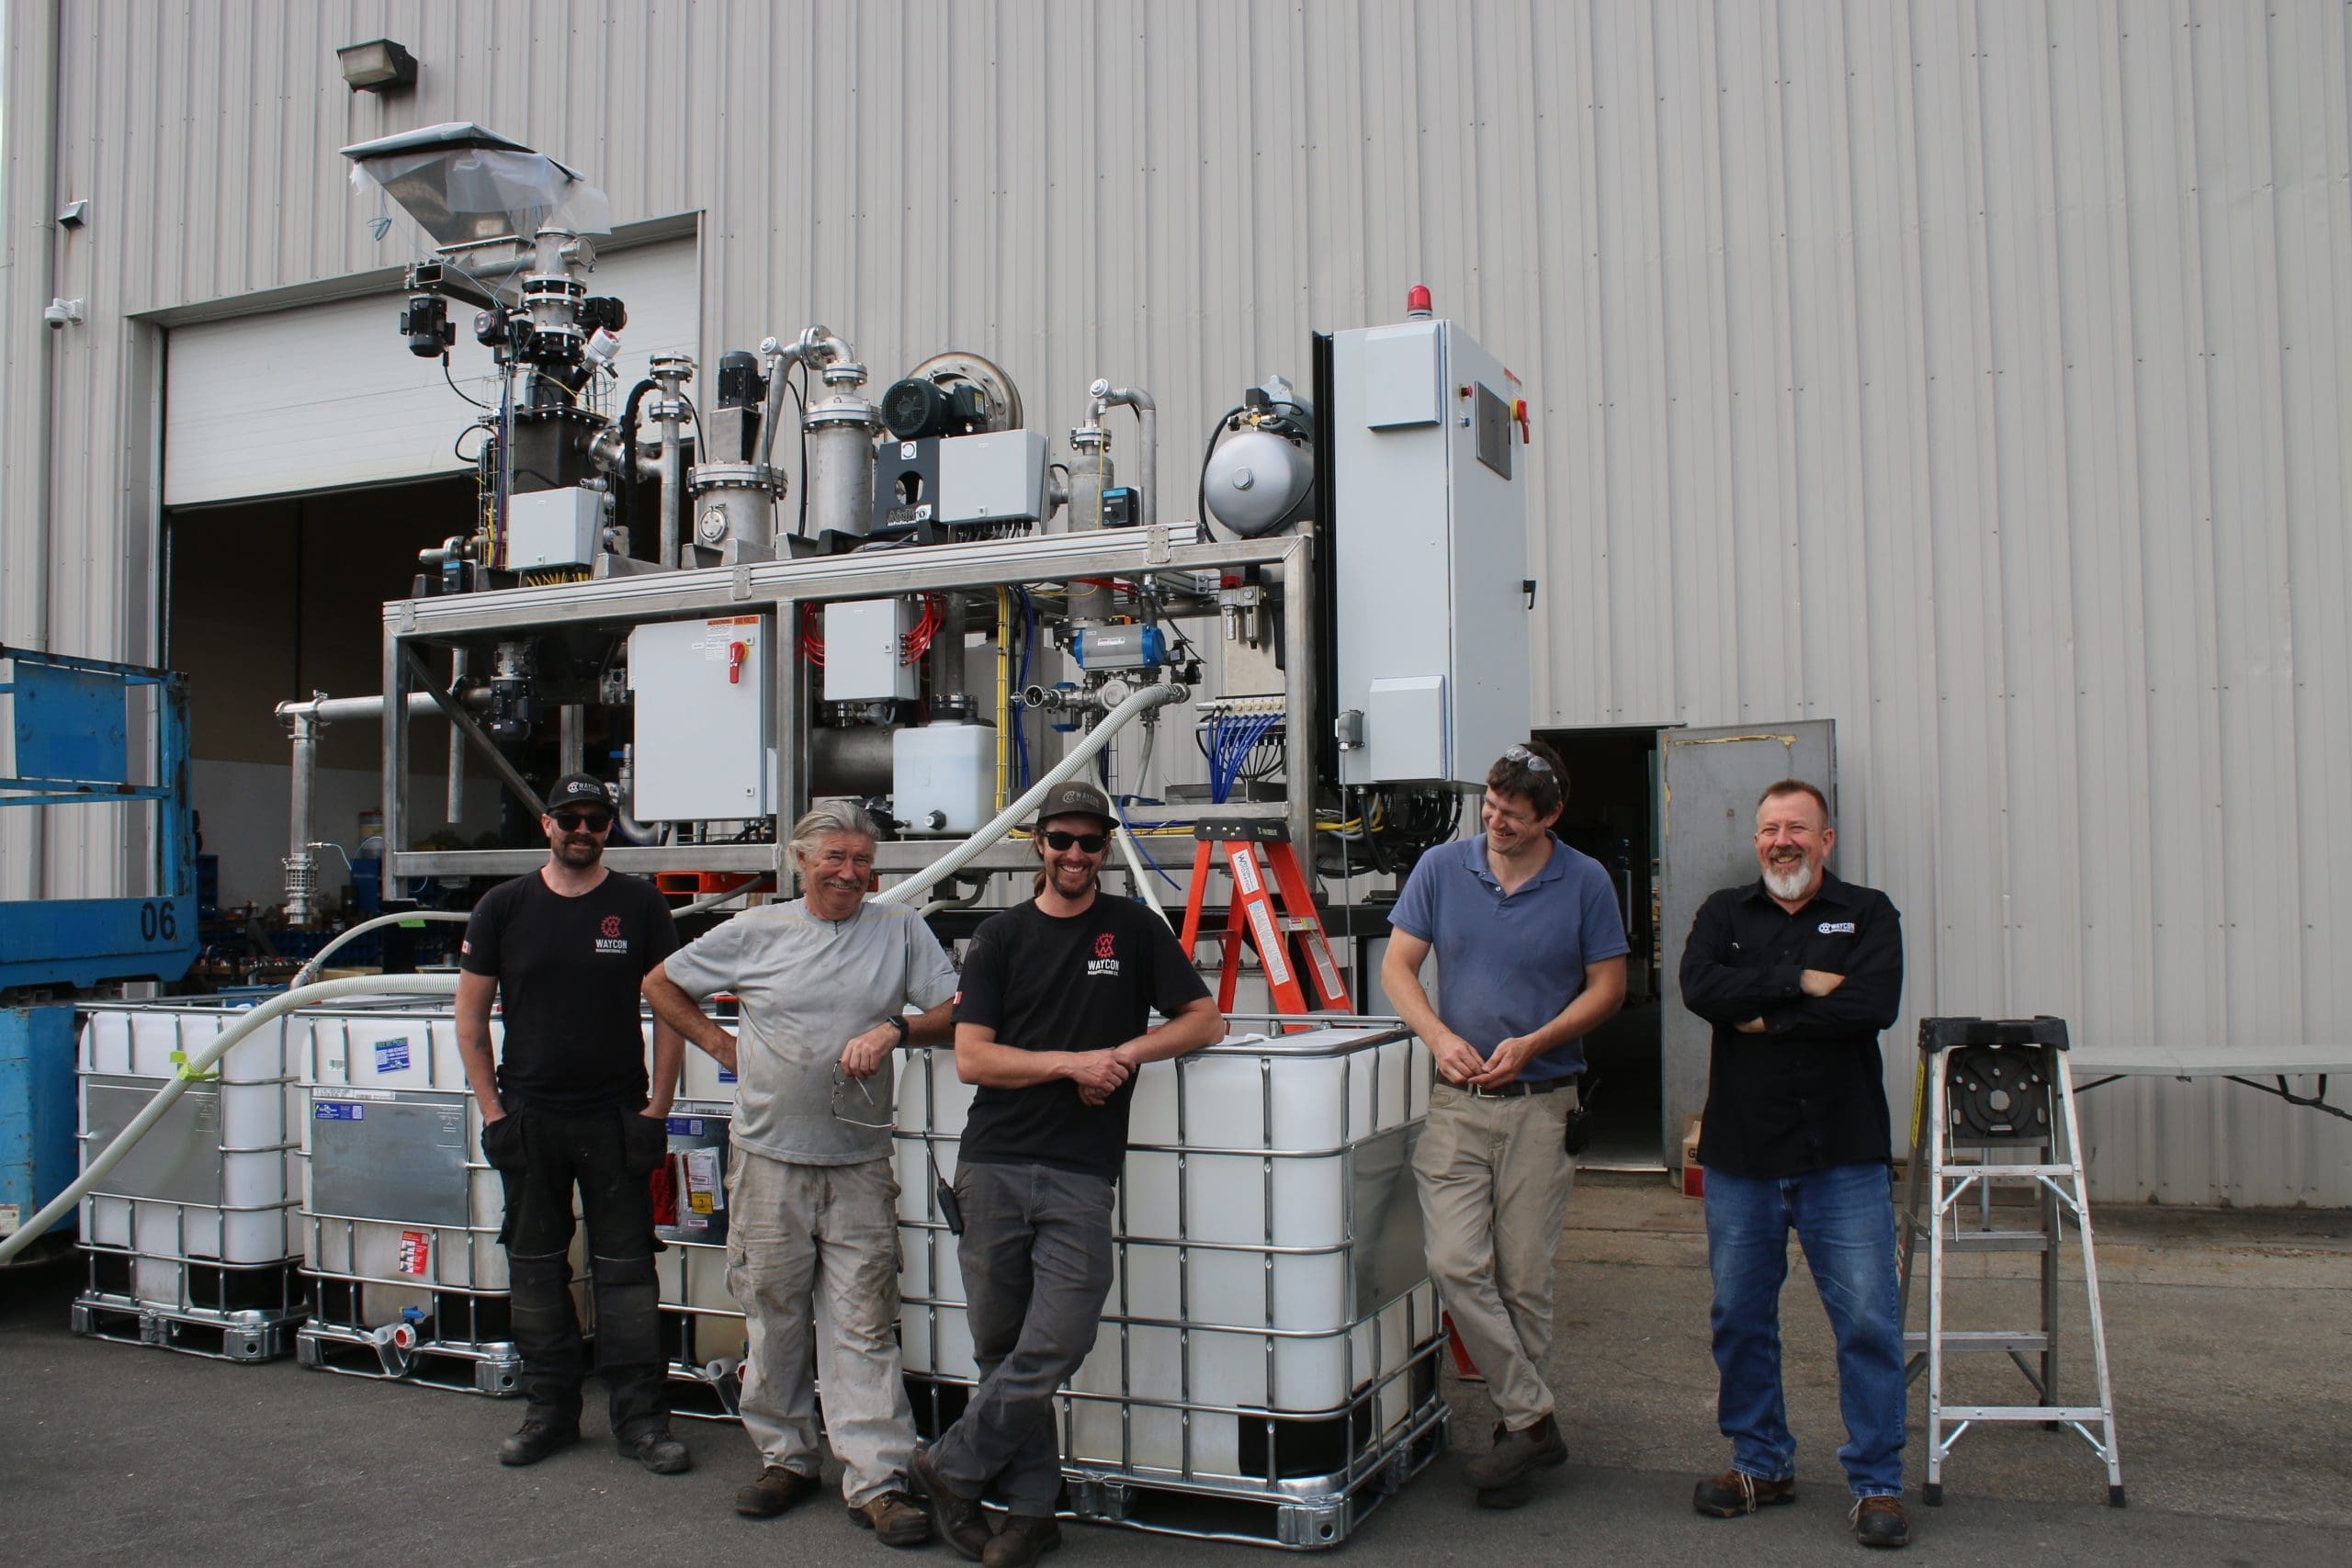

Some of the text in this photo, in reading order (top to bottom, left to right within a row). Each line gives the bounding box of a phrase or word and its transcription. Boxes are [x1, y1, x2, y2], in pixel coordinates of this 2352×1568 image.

[141, 901, 175, 942] 06
[595, 939, 628, 949] WAYCON
[1088, 959, 1119, 971] WAYCON
